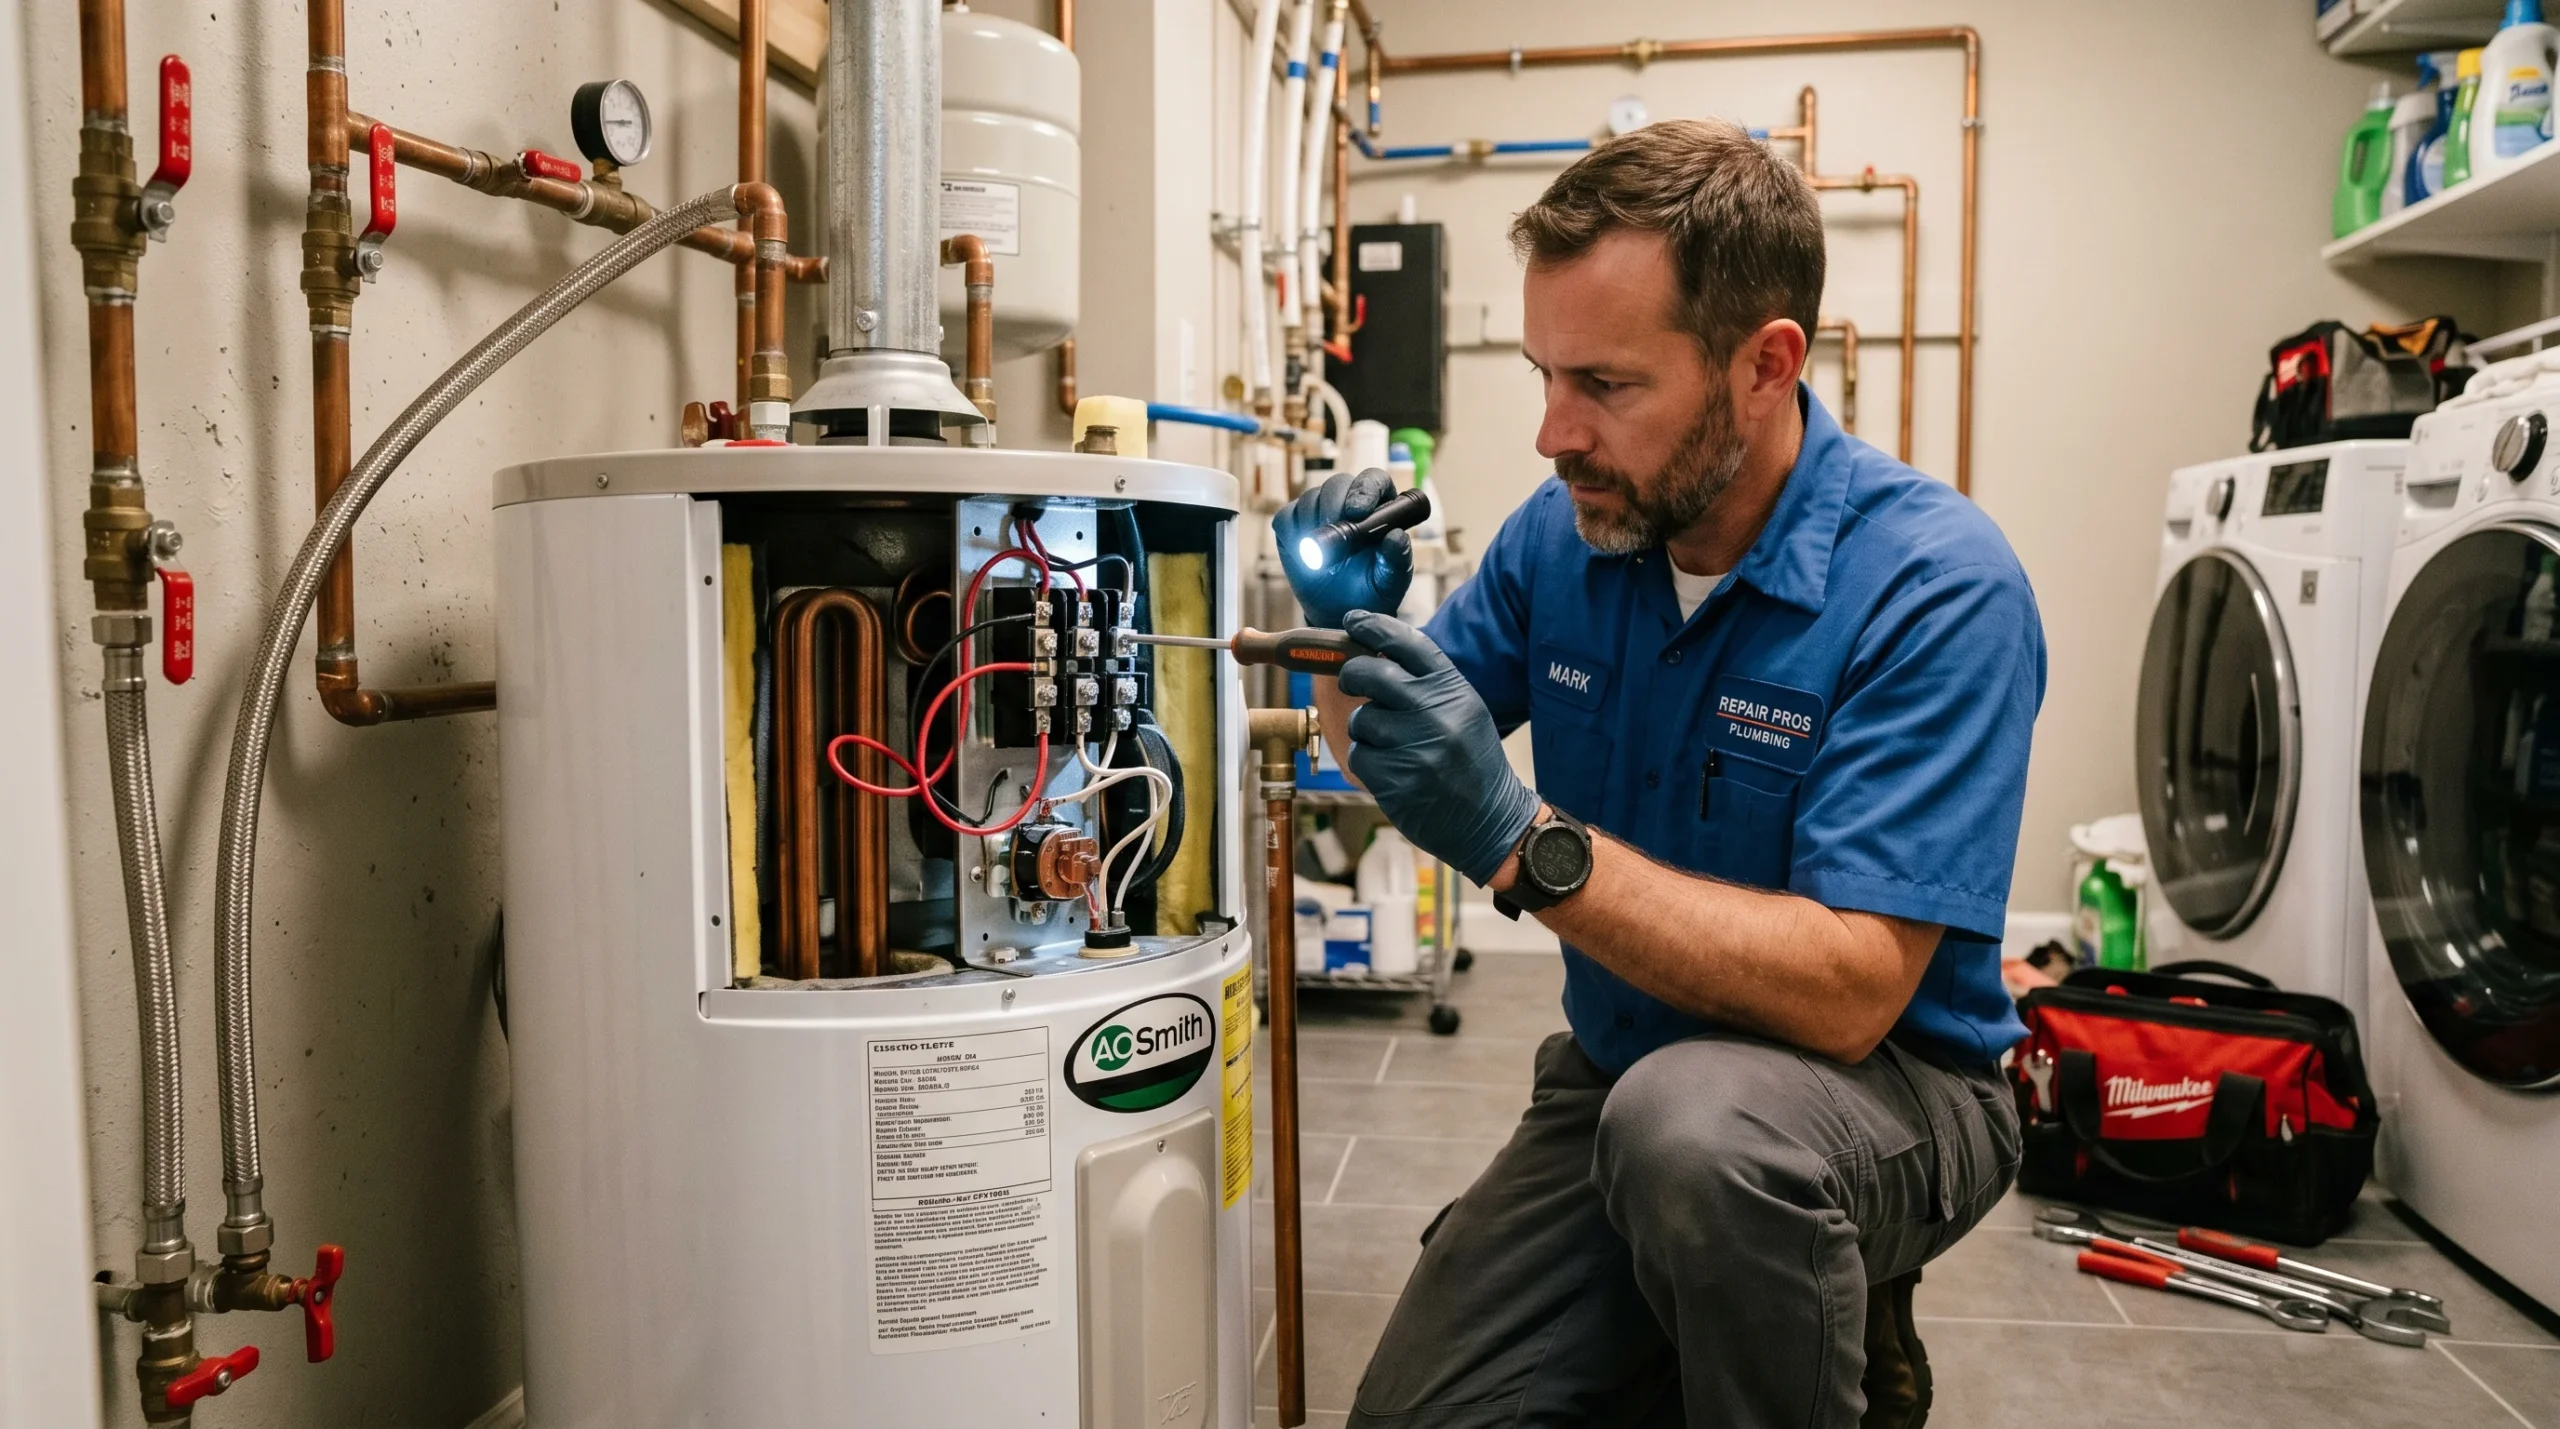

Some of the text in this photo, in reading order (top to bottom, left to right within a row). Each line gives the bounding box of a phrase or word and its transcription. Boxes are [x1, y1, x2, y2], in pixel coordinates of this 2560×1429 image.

[1548, 661, 1591, 694] MARK
[1718, 695, 1812, 732] REPAIR PROS
[1728, 722, 1791, 750] PLUMBING
[2104, 1074, 2213, 1107] Milwaukee
